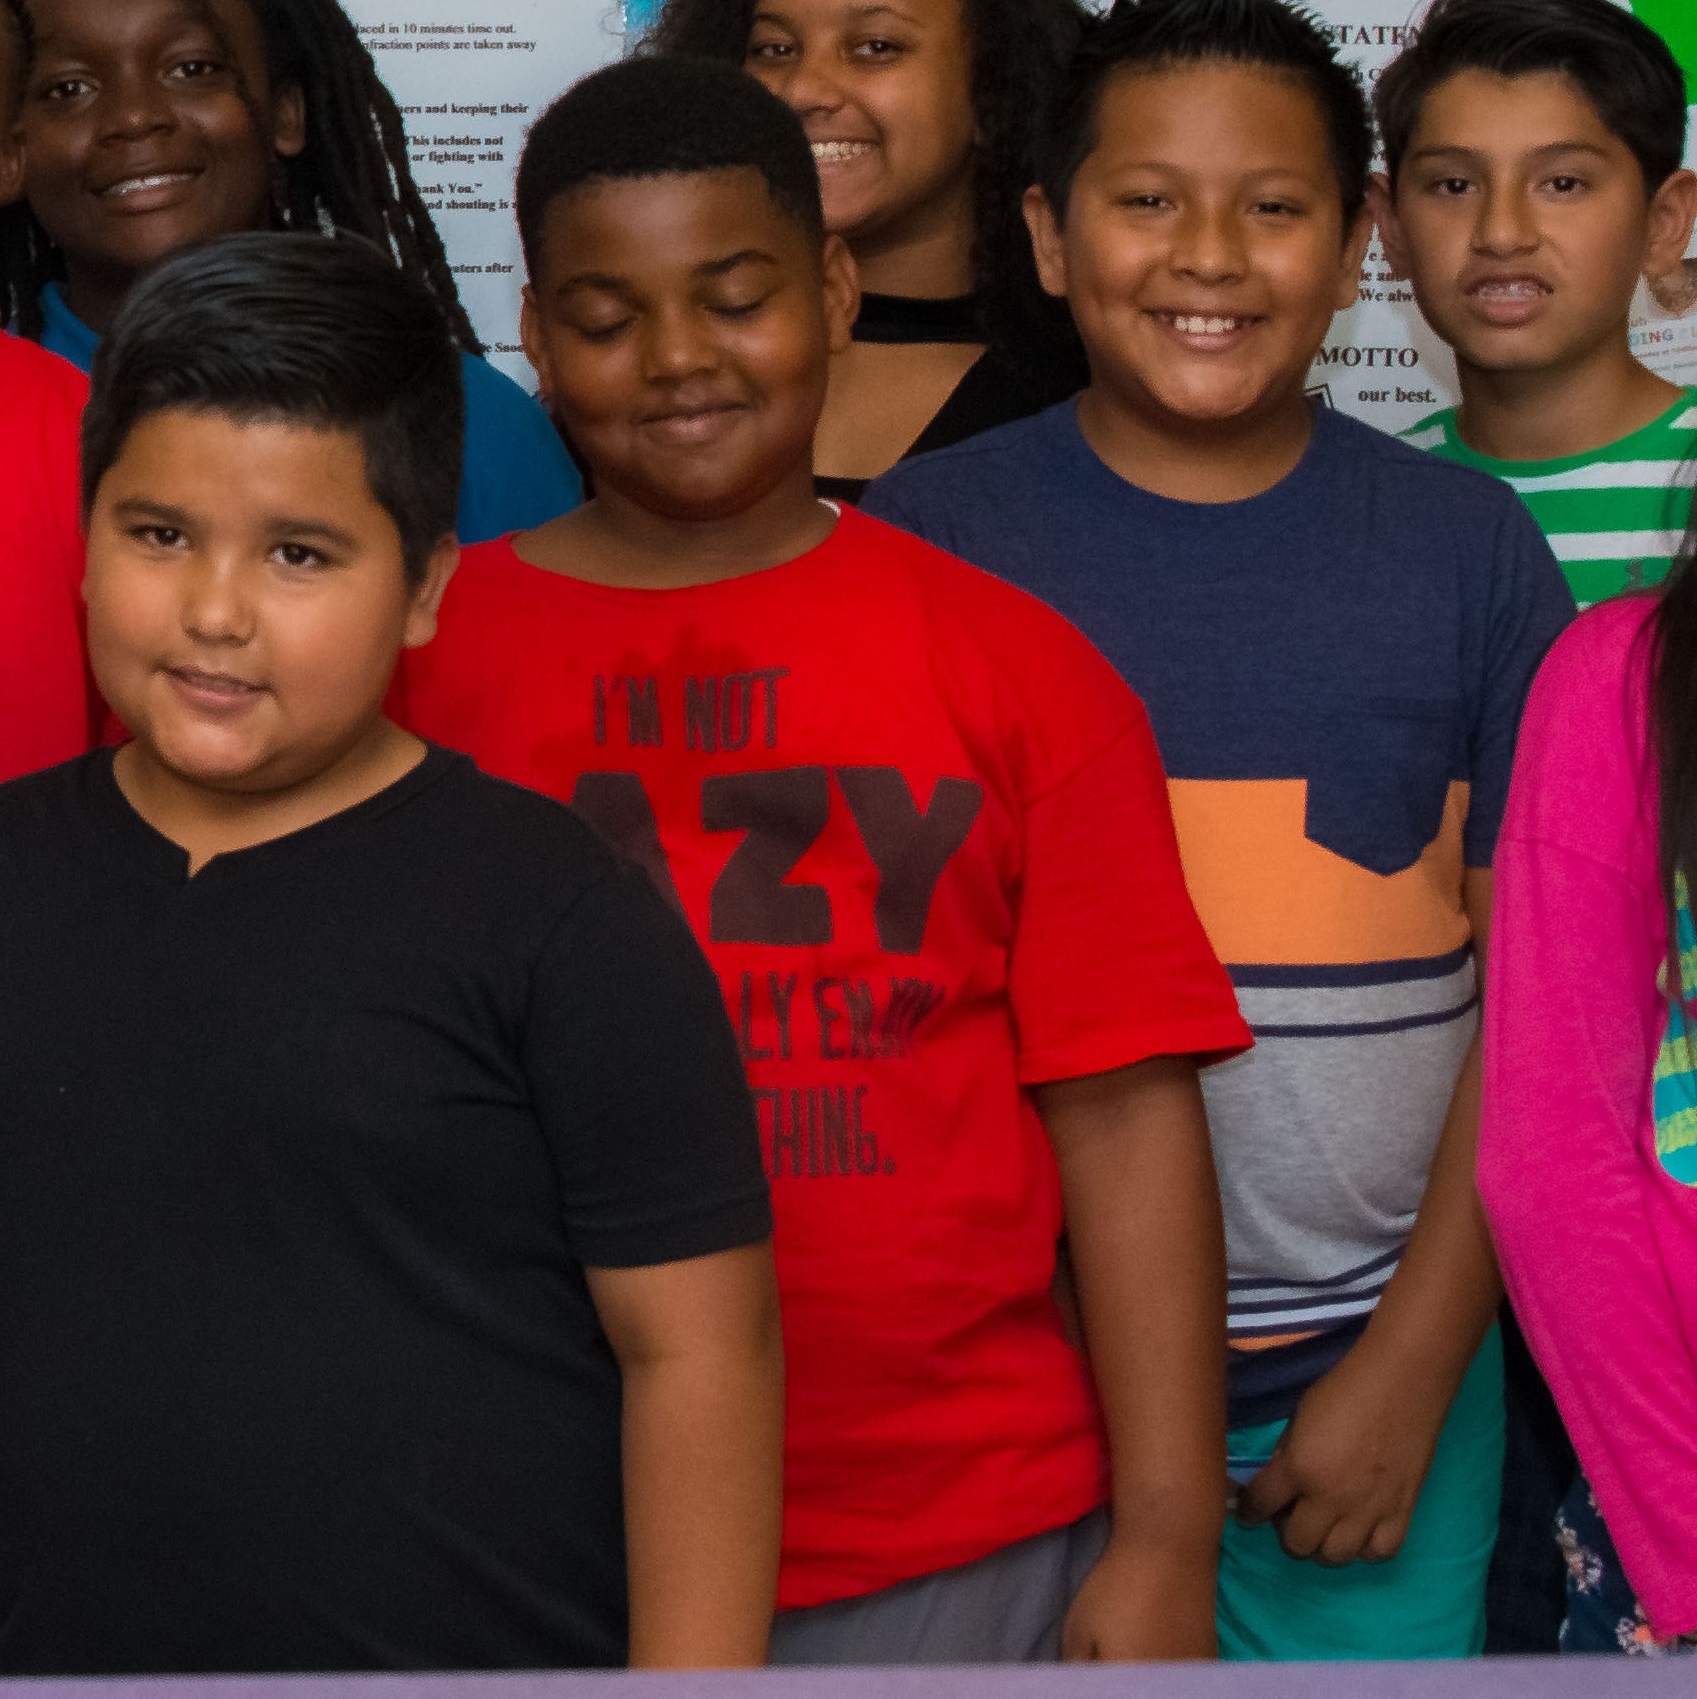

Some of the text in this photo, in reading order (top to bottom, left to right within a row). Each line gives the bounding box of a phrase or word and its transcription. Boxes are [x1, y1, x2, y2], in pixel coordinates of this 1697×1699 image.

[388, 22, 399, 34] in
[403, 22, 418, 34] 10
[420, 22, 465, 34] minutes
[467, 22, 492, 34] time
[495, 23, 517, 34] out.
[416, 38, 450, 52] points
[453, 41, 470, 50] are
[473, 38, 504, 50] taken
[507, 41, 537, 53] away
[425, 103, 447, 114] and
[451, 103, 497, 117] keeping
[501, 103, 529, 114] their
[433, 134, 481, 146] includes
[484, 136, 504, 146] not
[412, 151, 504, 165] or fighting with
[446, 198, 496, 212] shouting
[499, 198, 509, 210] is
[484, 261, 514, 274] after
[1314, 346, 1421, 369] MOTTO
[1358, 386, 1438, 404] our best.
[594, 667, 790, 753] I'M NOT
